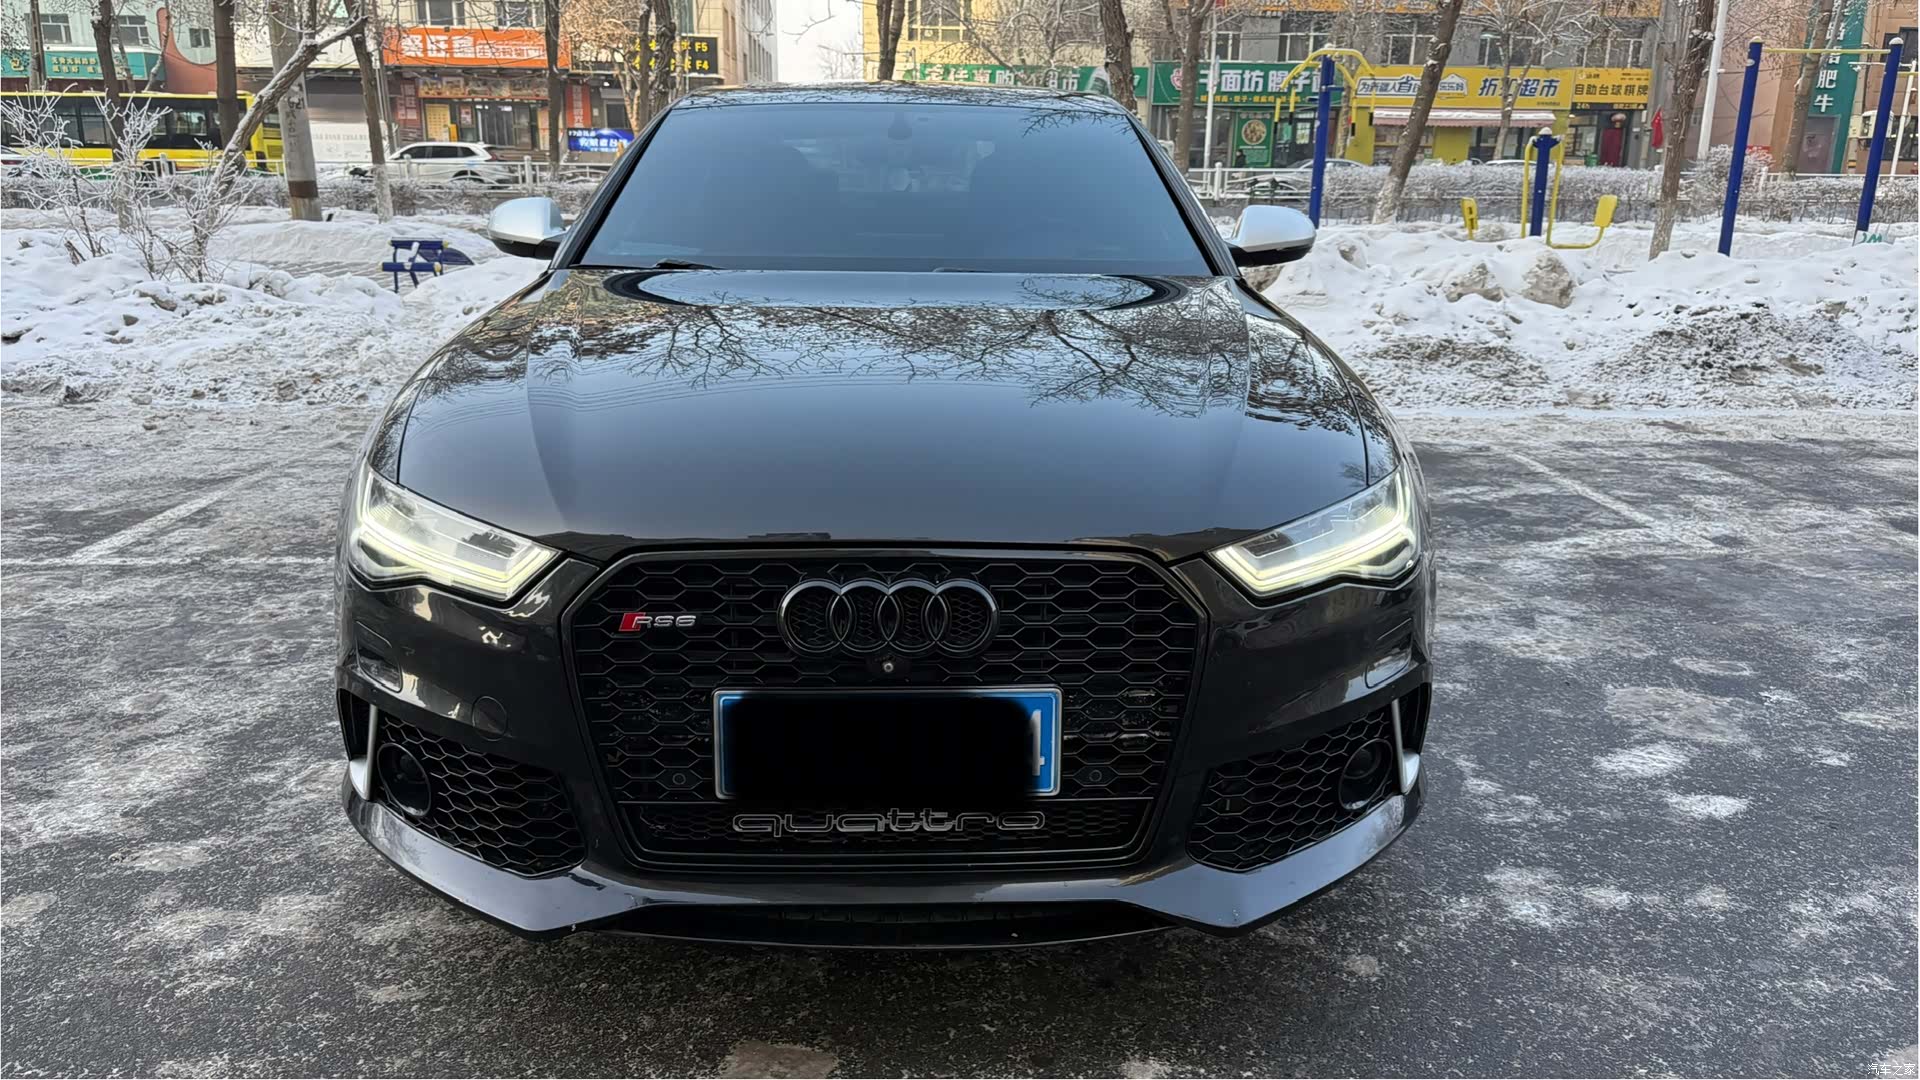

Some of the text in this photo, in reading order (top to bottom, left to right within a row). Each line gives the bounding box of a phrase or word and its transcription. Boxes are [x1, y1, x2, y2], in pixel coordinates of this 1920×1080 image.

[694, 42, 708, 52] F5
[695, 60, 710, 70] F4
[1574, 83, 1649, 96] 自助台球棋牌
[631, 614, 697, 629] RS6
[732, 808, 1046, 837] quattro
